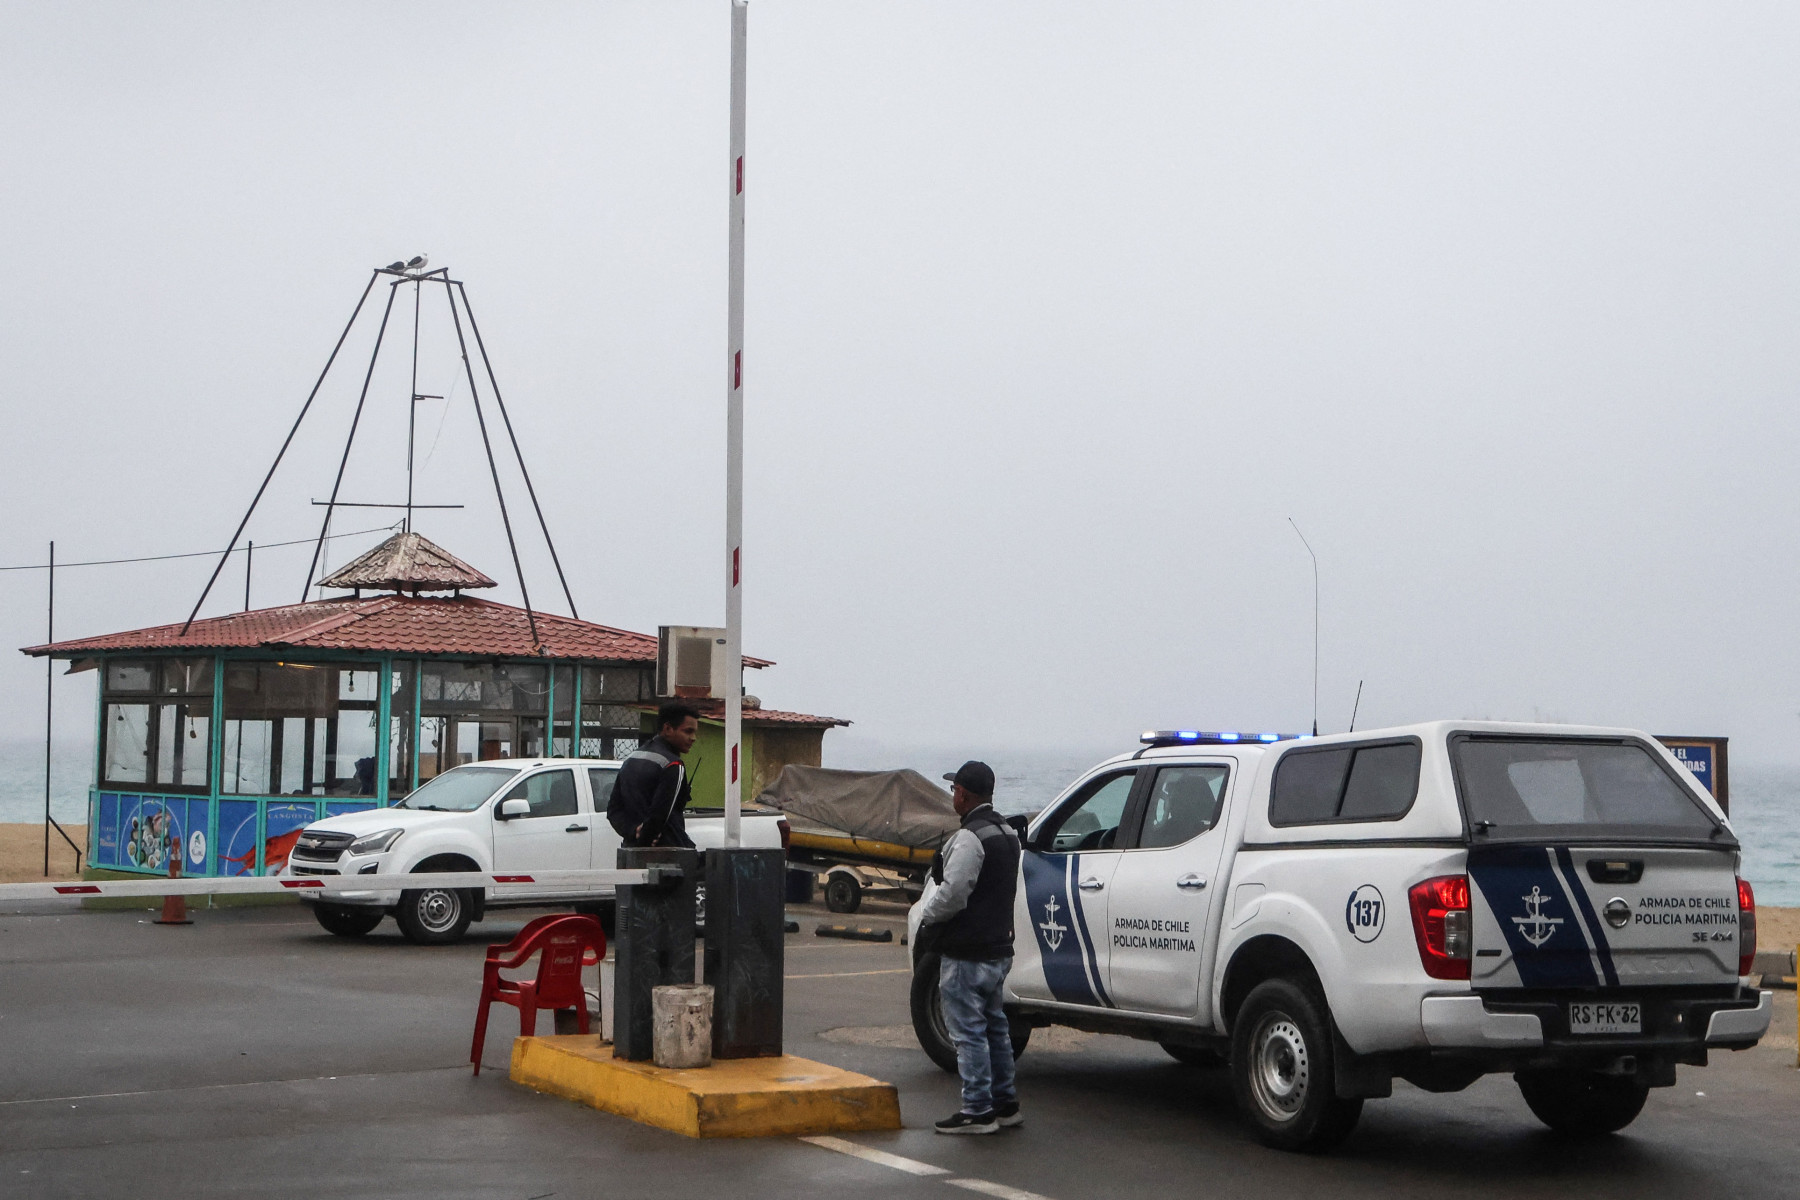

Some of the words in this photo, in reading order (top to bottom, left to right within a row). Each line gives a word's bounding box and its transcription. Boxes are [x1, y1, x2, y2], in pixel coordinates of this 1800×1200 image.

[1678, 748, 1687, 759] EL
[1639, 898, 1686, 908] ARMADA
[1688, 898, 1702, 908] DE
[1704, 898, 1731, 908] CHILE
[1354, 900, 1380, 926] 137
[1635, 913, 1682, 925] POLICIA
[1685, 913, 1738, 925] MARITIMA
[1115, 918, 1150, 931] ARMADA
[1151, 919, 1163, 932] DE
[1164, 920, 1190, 933] CHILE
[1692, 931, 1708, 942] SE
[1114, 935, 1147, 948] POLICIA
[1149, 937, 1195, 952] MARITIMA
